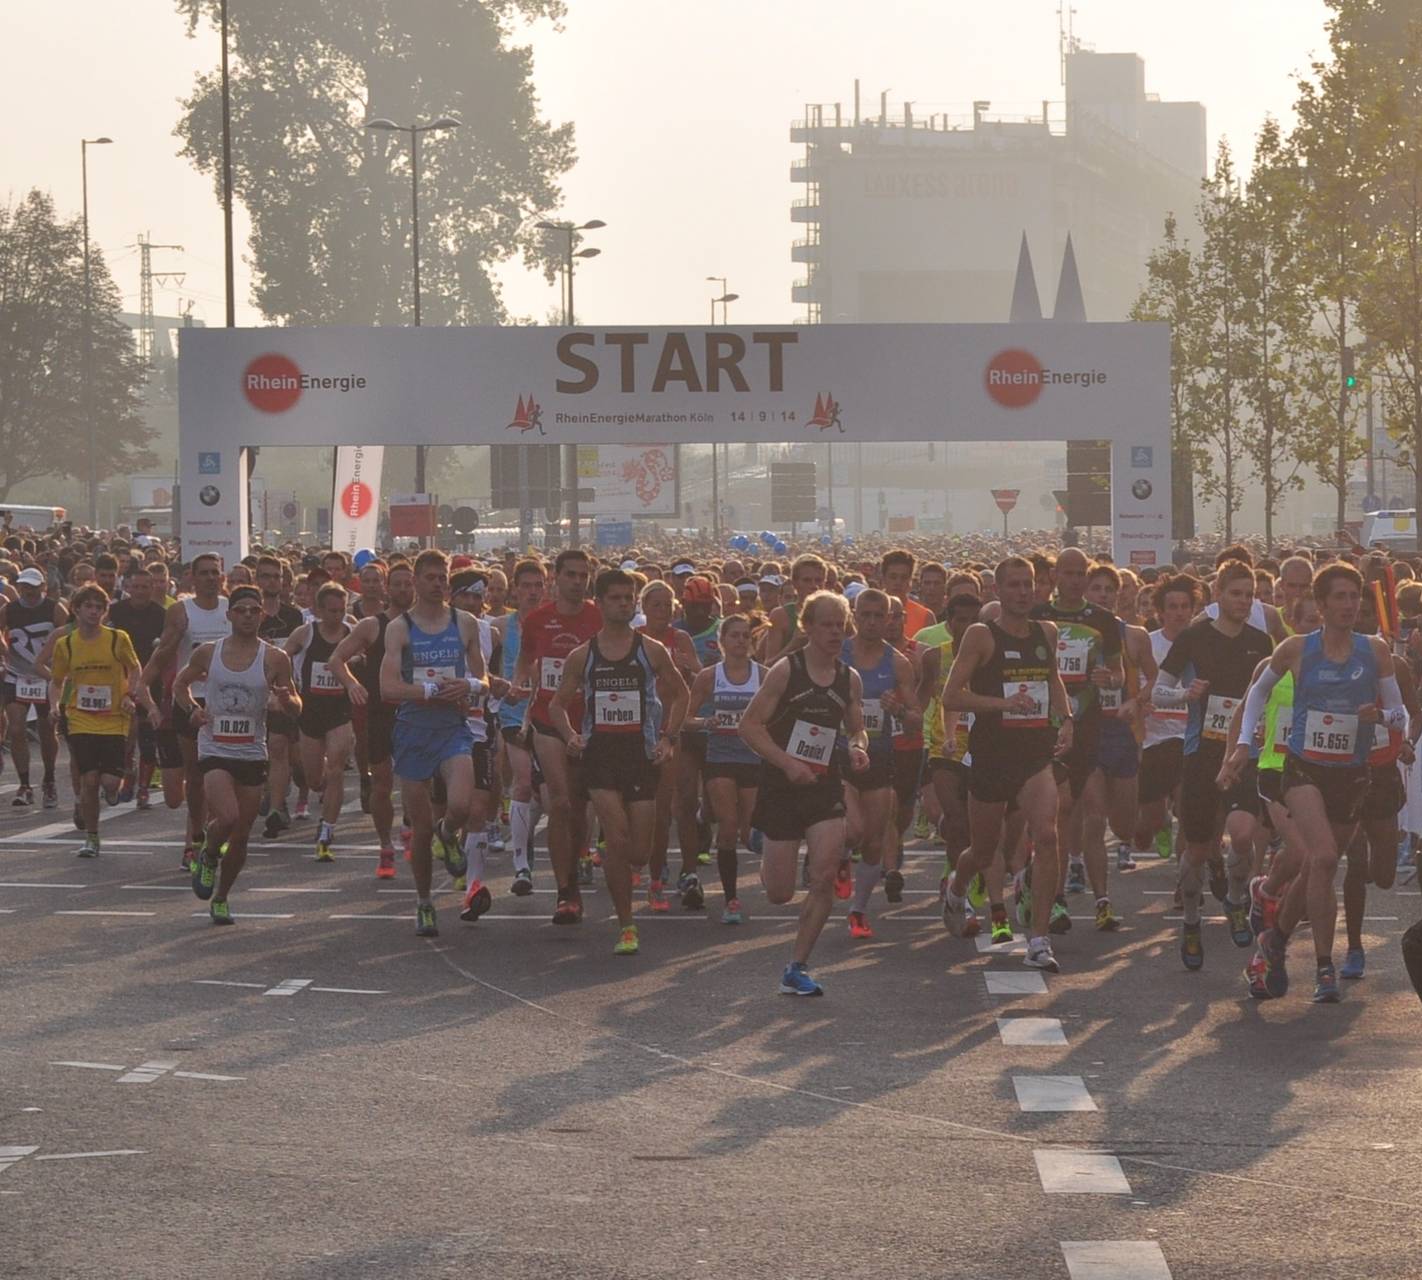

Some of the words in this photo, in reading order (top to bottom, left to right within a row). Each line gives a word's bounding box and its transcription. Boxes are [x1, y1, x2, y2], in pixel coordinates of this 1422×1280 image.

[556, 332, 799, 394] START
[247, 374, 366, 392] RheinEnergie
[989, 369, 1107, 388] RheinEnergie
[555, 412, 688, 426] RheinEnergieMarathon
[690, 411, 714, 423] Köln
[731, 411, 745, 423] 14
[758, 411, 767, 423] 9
[781, 410, 796, 423] 14
[412, 647, 460, 661] ENGELS
[595, 677, 639, 688] ENGELS
[602, 707, 633, 722] Torben
[220, 719, 250, 734] 10.028
[1312, 731, 1350, 750] 15.655
[796, 740, 826, 761] Daniel
